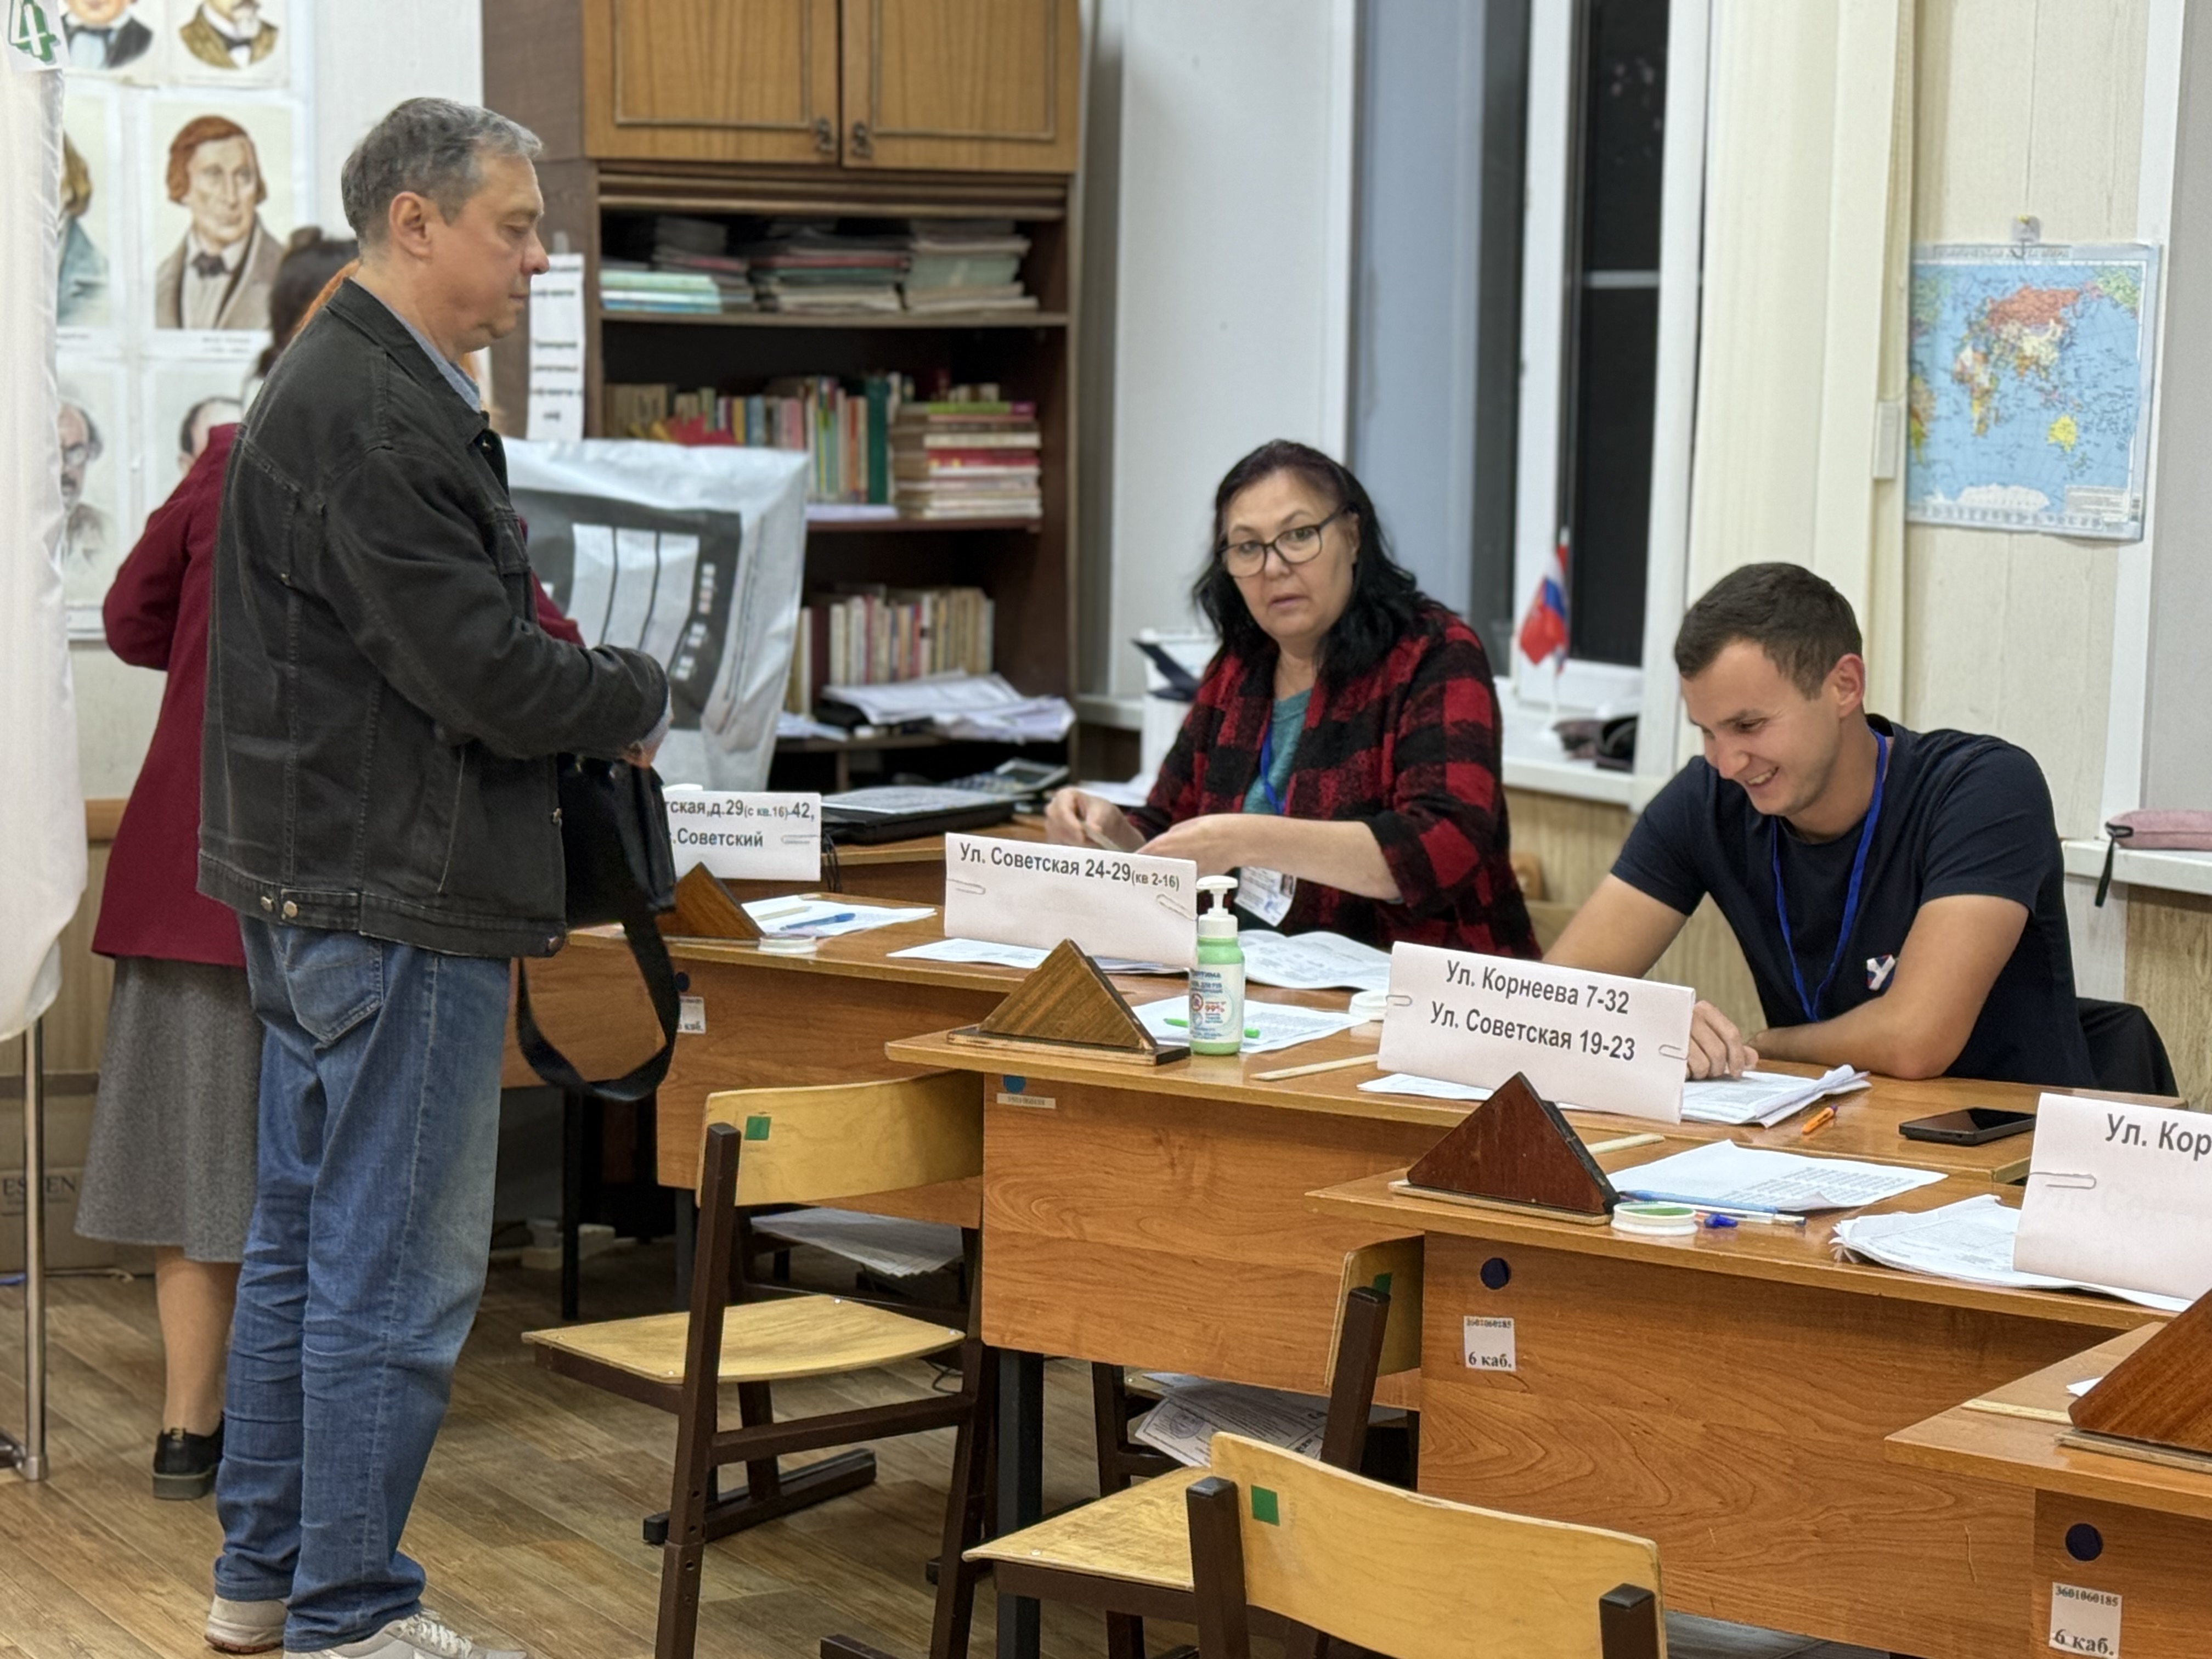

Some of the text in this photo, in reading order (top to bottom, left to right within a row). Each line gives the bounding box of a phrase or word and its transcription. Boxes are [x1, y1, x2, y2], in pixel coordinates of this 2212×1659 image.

[960, 842, 986, 864] Ул.
[991, 847, 1080, 876] Советская
[1446, 960, 1630, 1015] Ул. Корнеева 7-32
[1431, 1001, 1636, 1061] Ул. Советская 19-23
[2105, 1113, 2211, 1161] Ул. Кор
[1468, 1351, 1512, 1368] 6 каб.
[2053, 1628, 2114, 1656] 6 каб.
